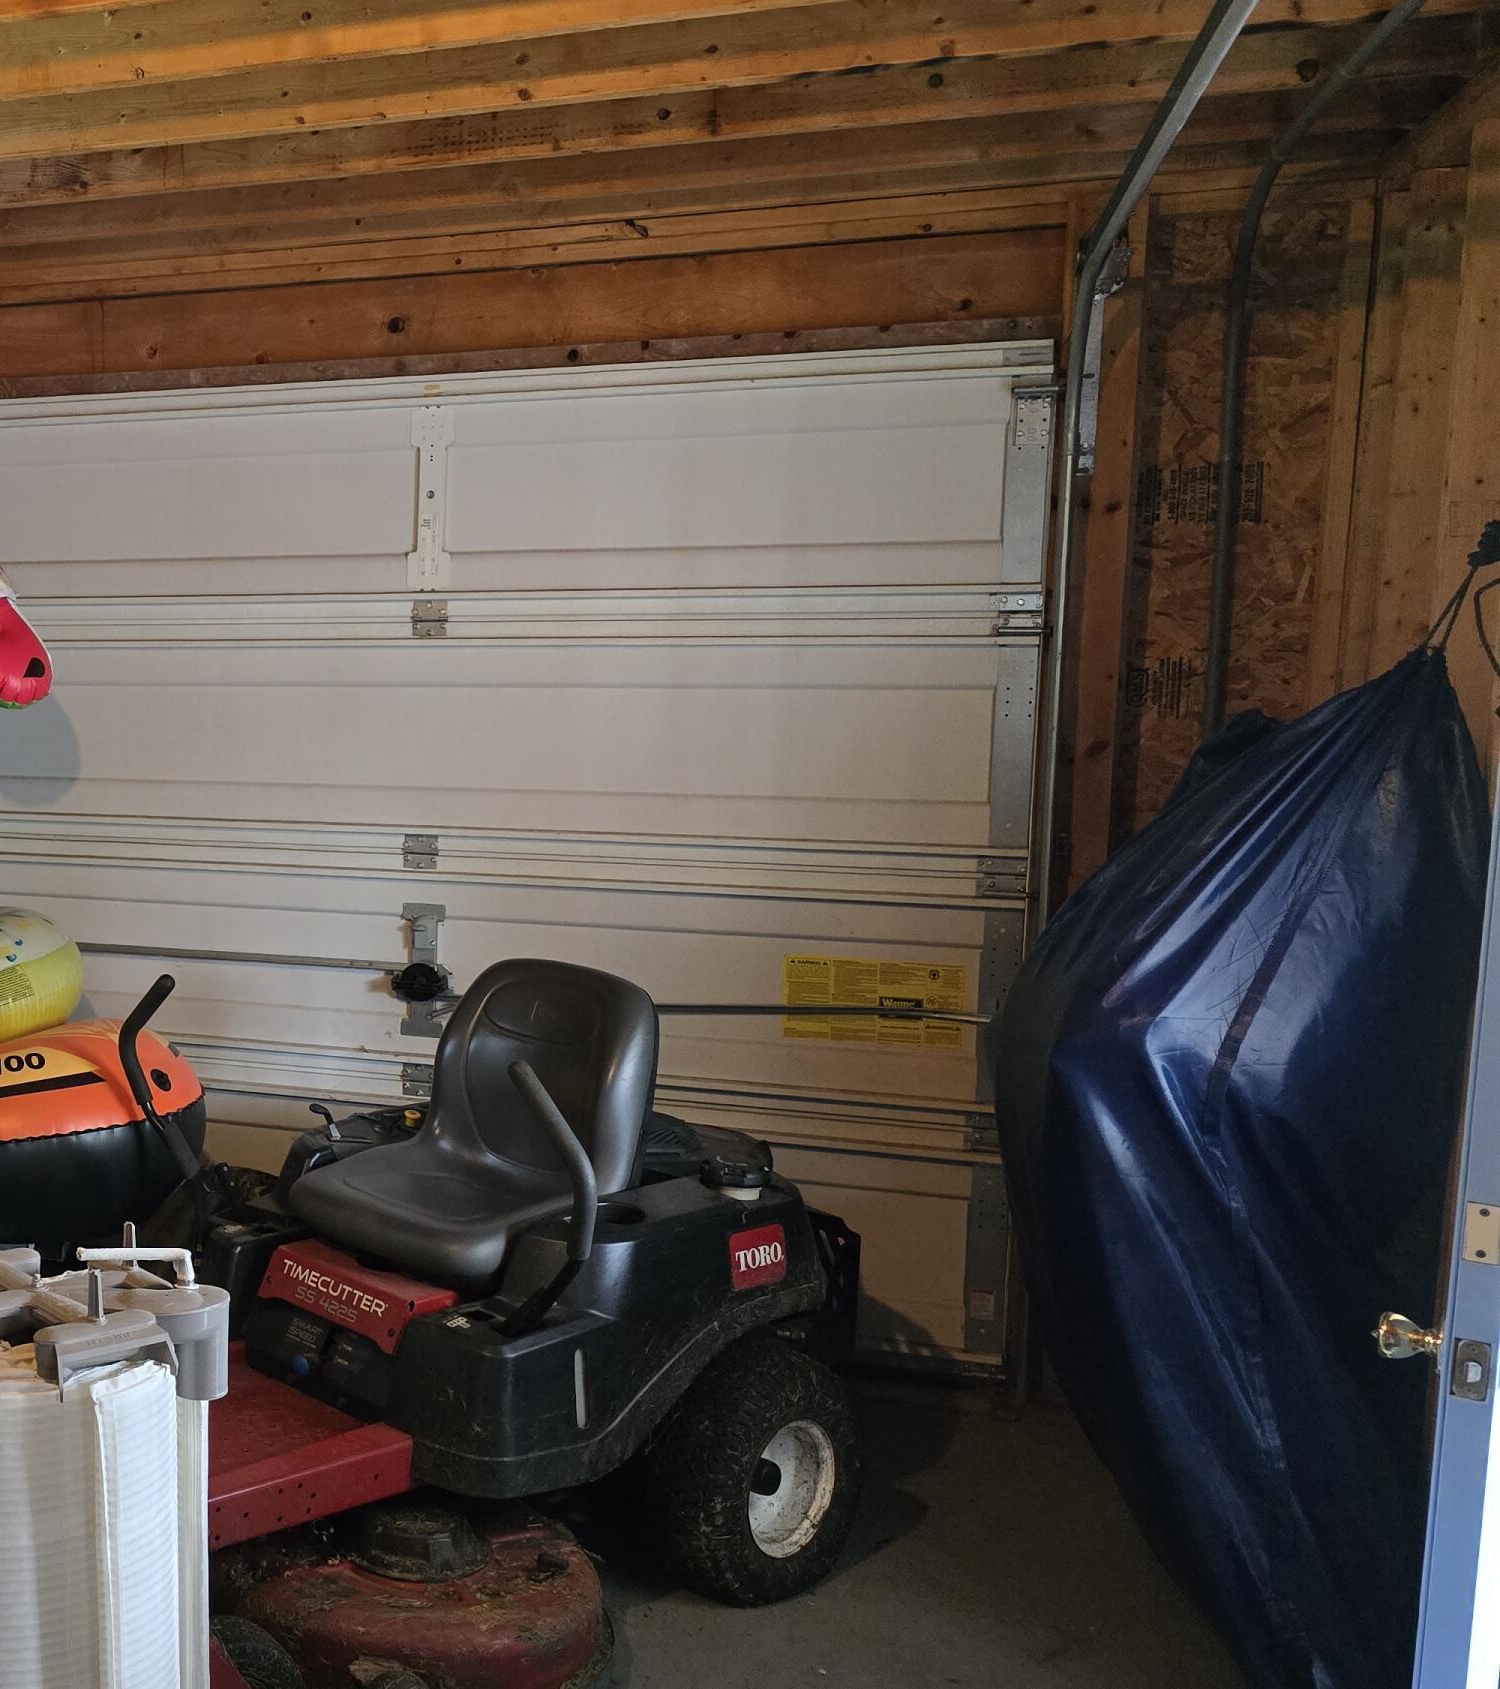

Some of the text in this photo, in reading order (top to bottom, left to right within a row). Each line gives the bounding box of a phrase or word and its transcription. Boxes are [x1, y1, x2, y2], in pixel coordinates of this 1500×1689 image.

[735, 1241, 782, 1273] TORO
[283, 1258, 387, 1318] TIMECUTTER
[294, 1286, 358, 1324] SS 4225
[287, 1325, 316, 1343] SPEED
[291, 1317, 322, 1336] SMART
